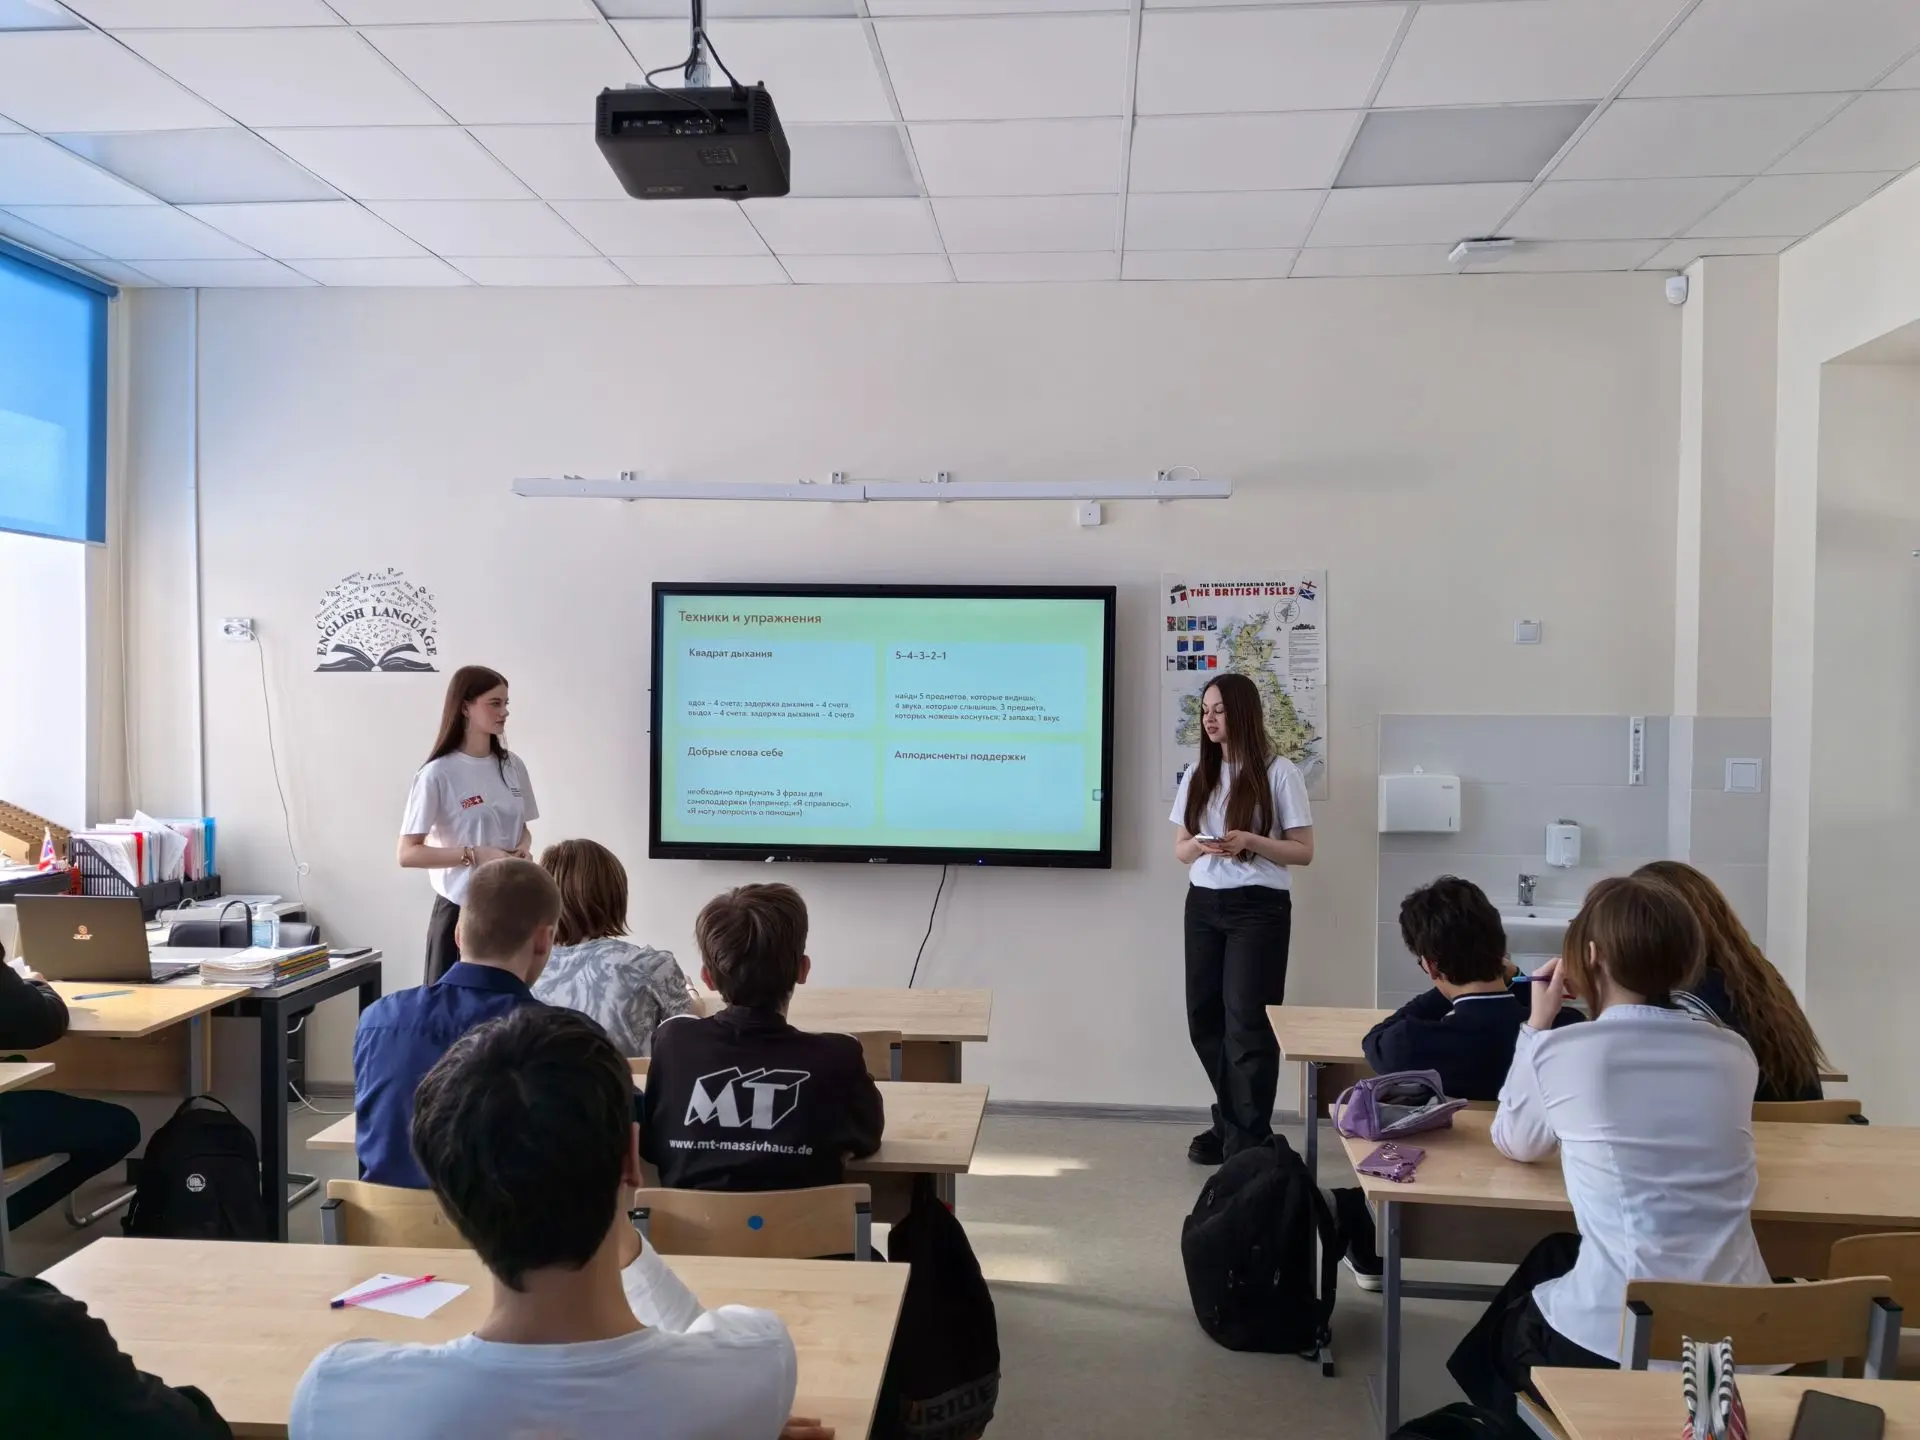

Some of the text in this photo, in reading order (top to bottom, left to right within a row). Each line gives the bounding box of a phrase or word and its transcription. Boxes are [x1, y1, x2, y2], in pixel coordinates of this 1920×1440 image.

[1190, 587, 1295, 597] THE BRITISH ISLES
[678, 610, 822, 626] Техники и упражнения
[316, 607, 365, 656] ENGLISH
[372, 606, 437, 656] LANGUAGE
[689, 648, 773, 659] Квадрат дыхания
[895, 692, 918, 700] найди
[970, 694, 1003, 702] которые
[744, 701, 780, 709] задержка
[1000, 703, 1006, 711] 3
[688, 710, 712, 718] выдох
[750, 711, 786, 719] задержка
[787, 711, 820, 719] дыхания
[1043, 715, 1060, 723] вкус
[687, 746, 784, 757] Добрые слова себе
[894, 750, 1026, 763] Аплодисменты поддержки
[687, 788, 733, 797] необходимо
[776, 789, 781, 797] 3
[782, 790, 808, 798] фразы
[687, 799, 747, 807] самоподдержки
[684, 1066, 810, 1130] MT
[669, 1138, 813, 1156] www.mt-massivhaus.de
